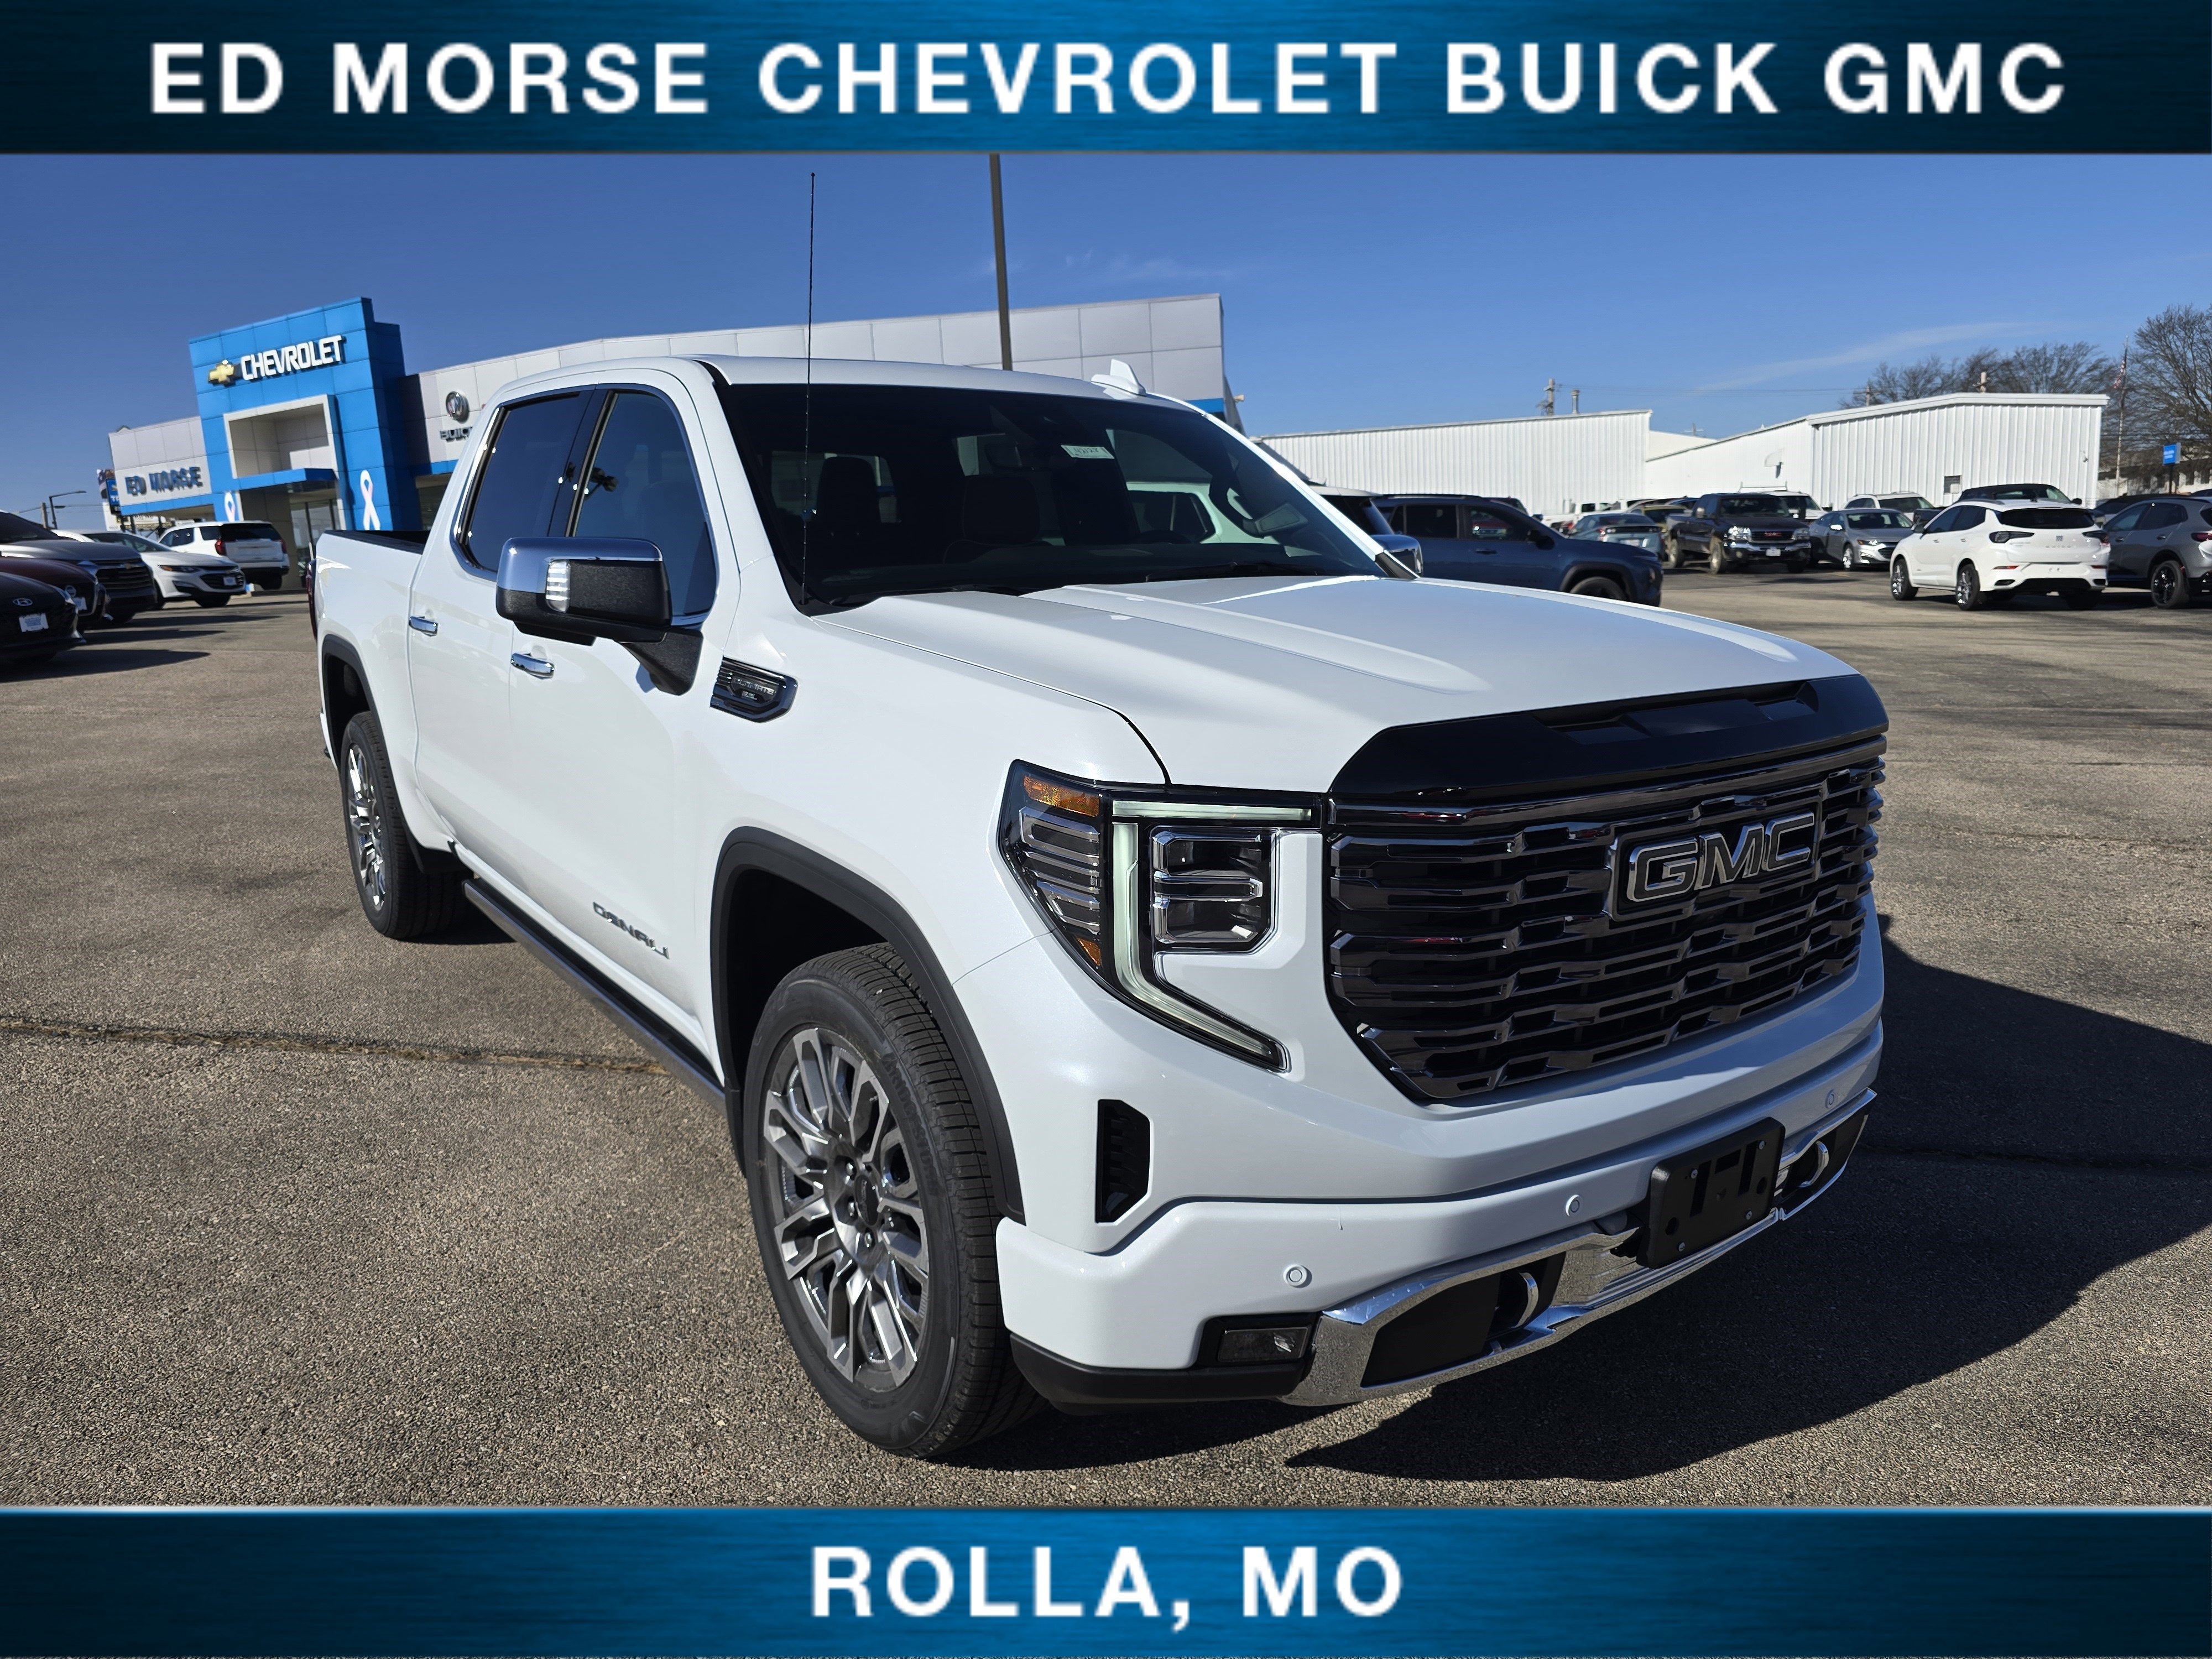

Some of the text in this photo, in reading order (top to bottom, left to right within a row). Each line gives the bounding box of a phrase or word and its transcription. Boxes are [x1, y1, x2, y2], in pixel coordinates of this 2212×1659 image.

[240, 334, 343, 380] CHEVROLET
[440, 426, 473, 441] BUIC
[124, 466, 203, 496] ED MORSE
[1626, 812, 1814, 902] GMC
[593, 901, 670, 960] DENALI
